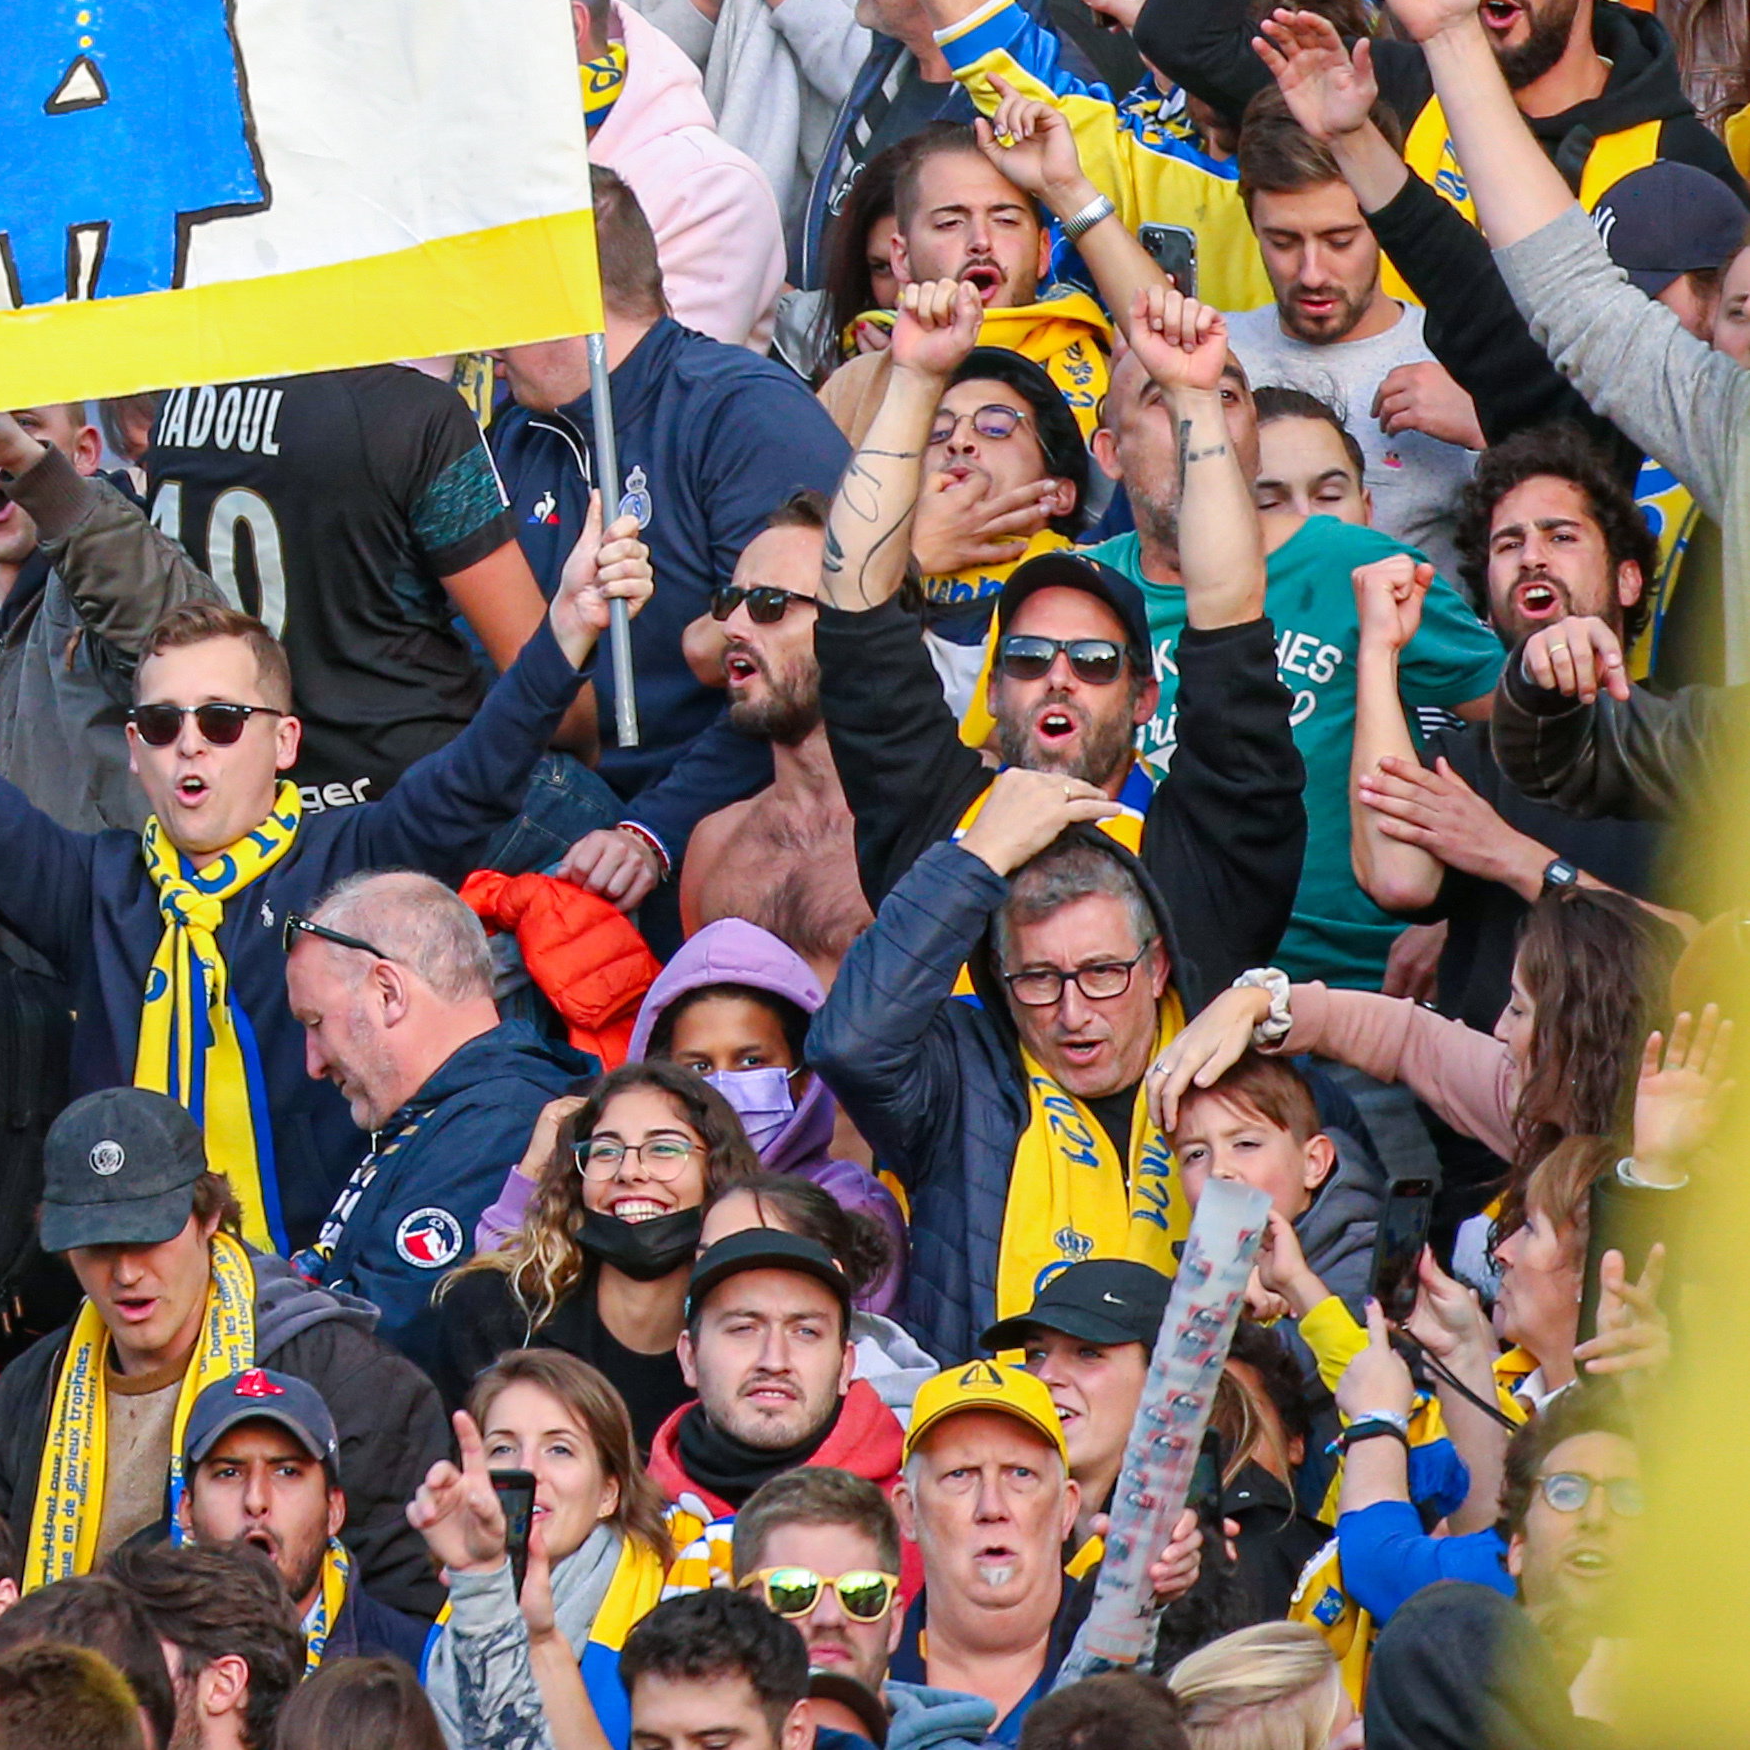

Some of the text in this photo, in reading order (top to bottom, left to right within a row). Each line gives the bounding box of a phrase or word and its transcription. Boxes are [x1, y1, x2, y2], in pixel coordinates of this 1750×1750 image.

[64, 1426, 82, 1493] glorieux
[65, 1500, 76, 1517] de
[63, 1524, 74, 1544] en
